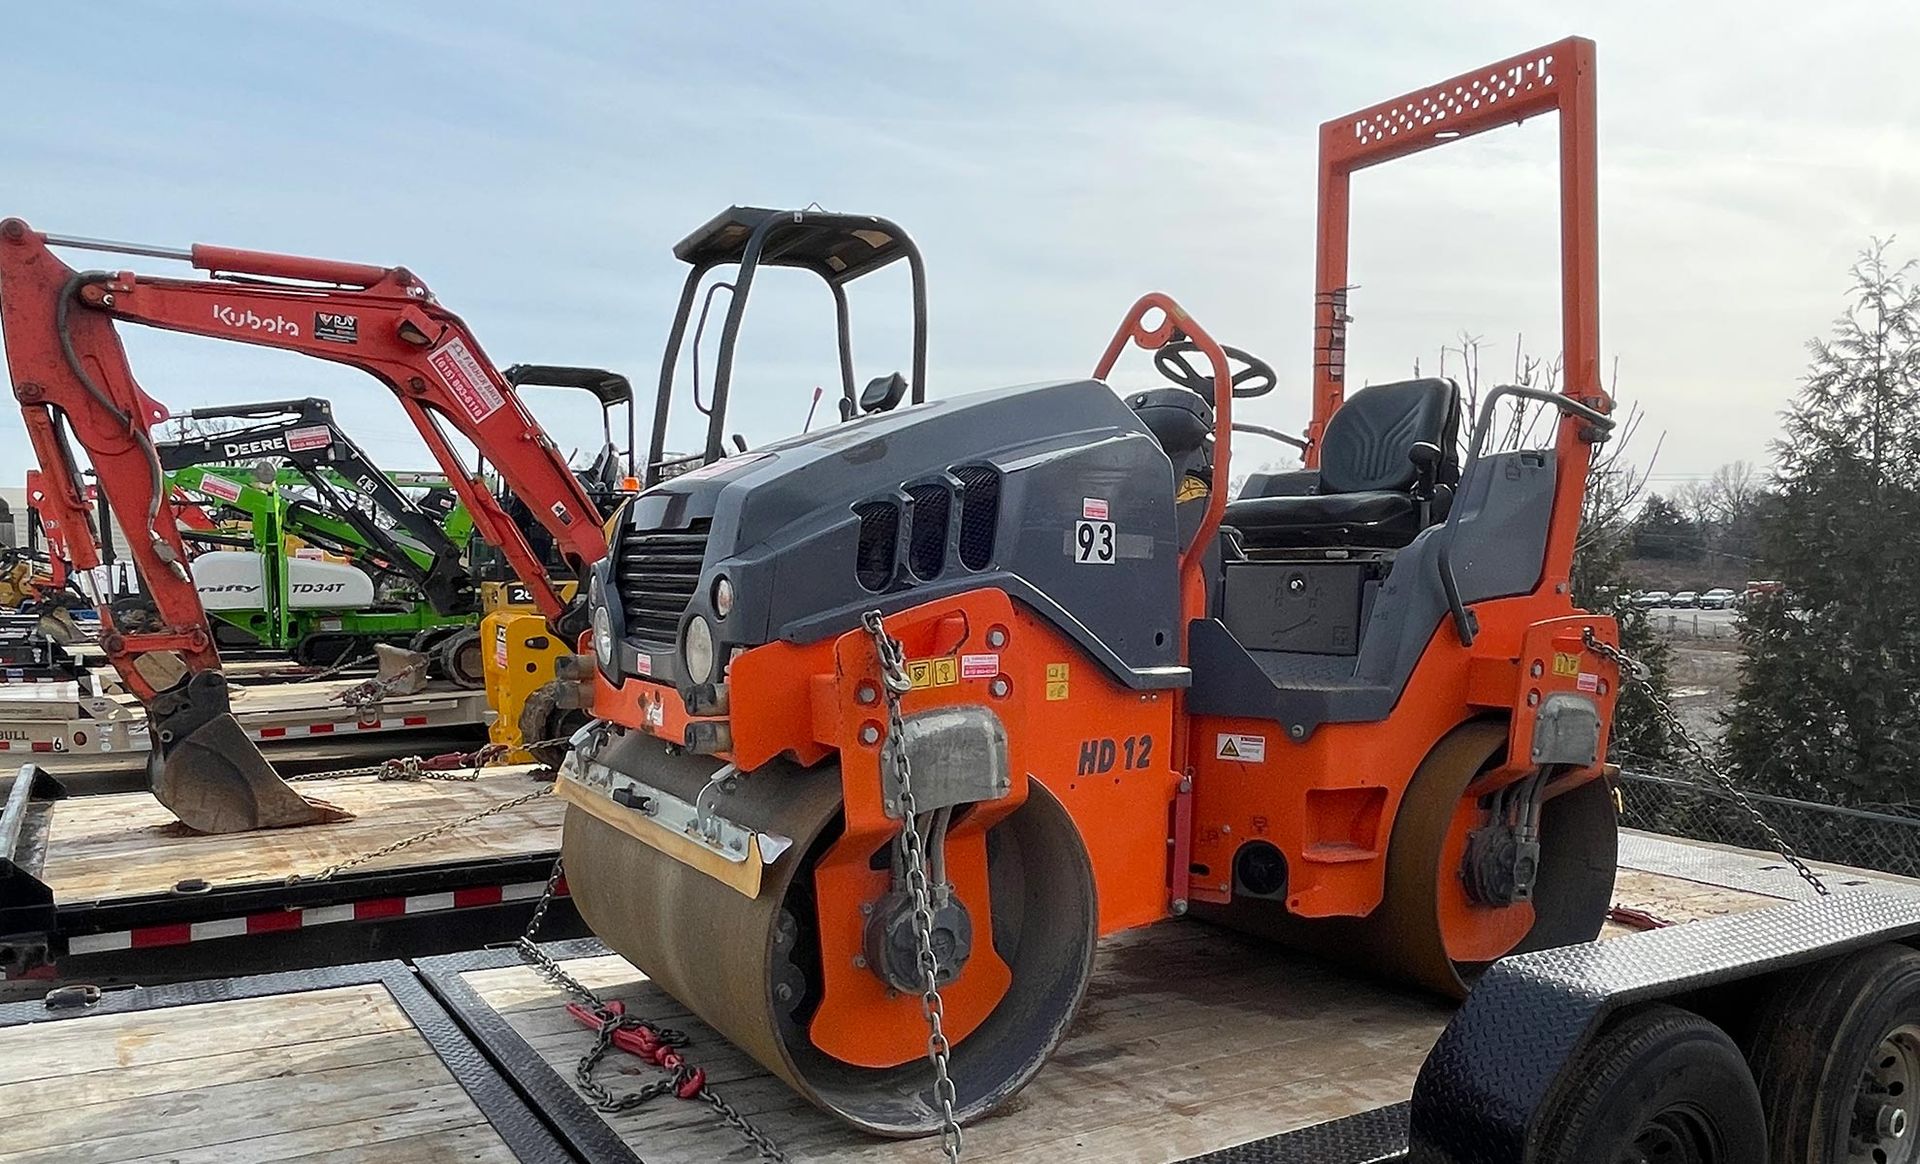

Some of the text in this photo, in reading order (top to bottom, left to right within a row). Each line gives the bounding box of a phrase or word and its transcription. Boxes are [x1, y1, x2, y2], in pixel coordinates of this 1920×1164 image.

[213, 304, 299, 337] Kubota
[224, 437, 286, 458] DEERE
[358, 477, 377, 493] 43
[1078, 523, 1114, 562] 93
[292, 583, 346, 594] TD34T
[53, 737, 63, 751] 6
[1078, 734, 1154, 776] HD 12
